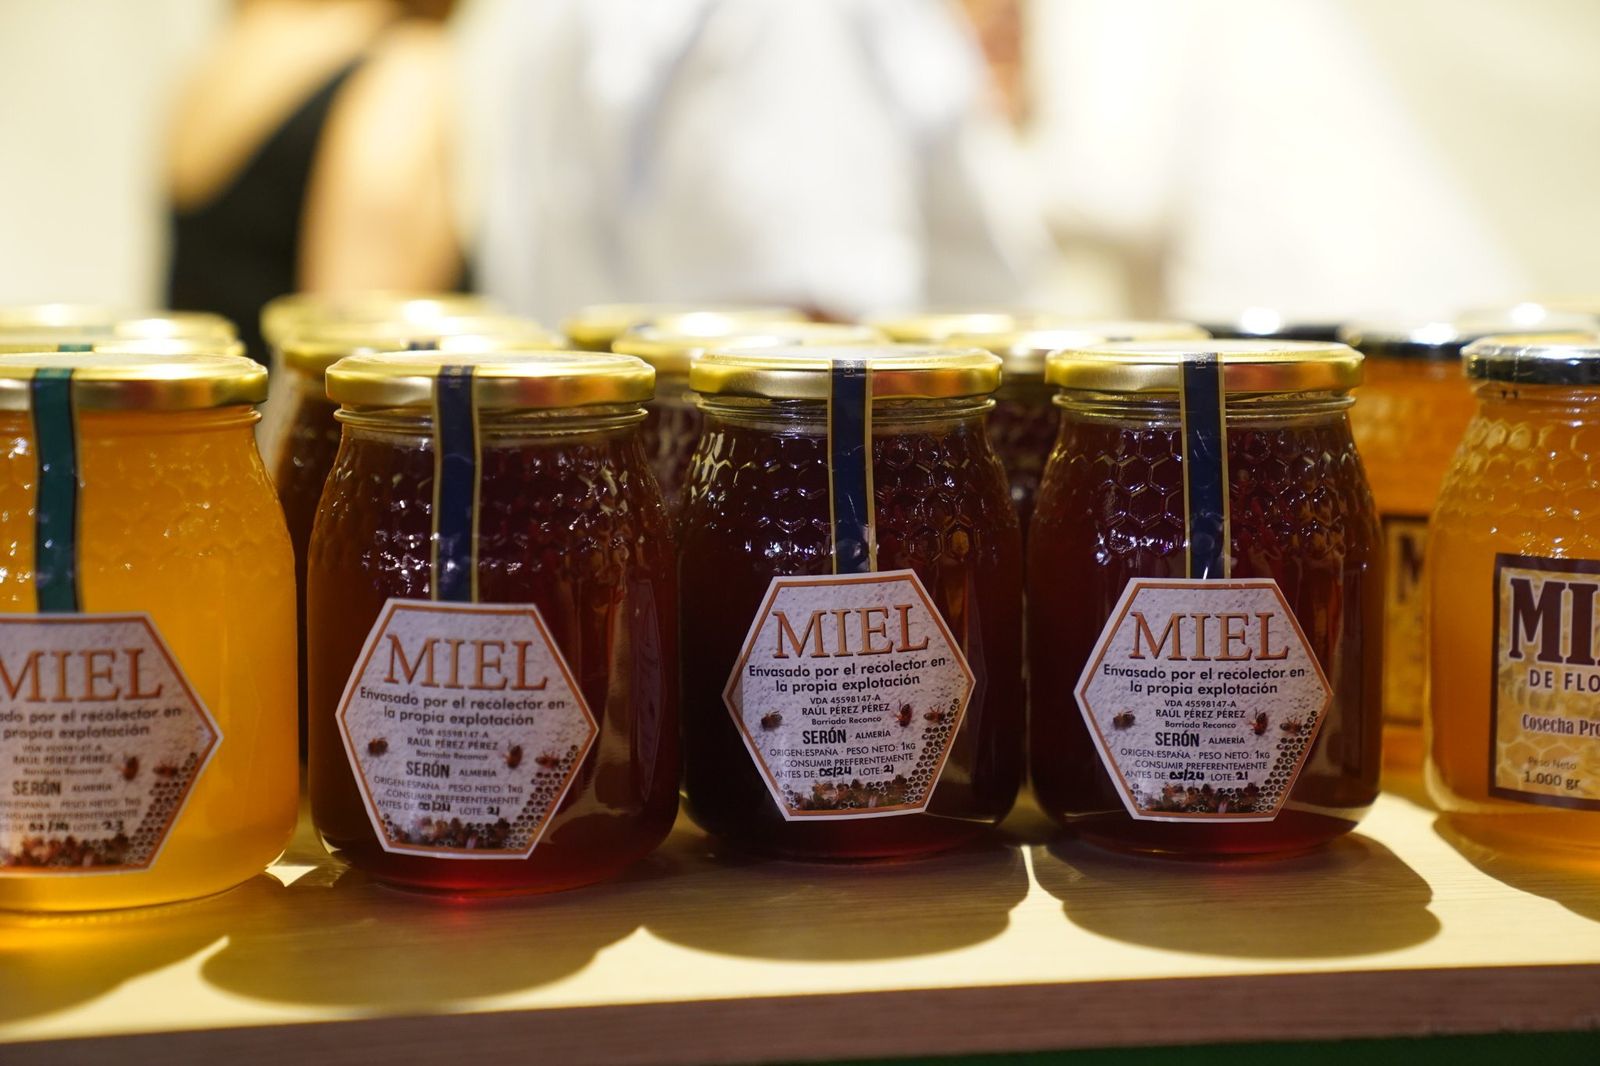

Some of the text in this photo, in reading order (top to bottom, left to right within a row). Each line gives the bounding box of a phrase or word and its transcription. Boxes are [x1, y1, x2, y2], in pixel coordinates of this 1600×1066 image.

[1508, 577, 1600, 666] MI
[771, 603, 931, 659] MIEL
[1128, 611, 1290, 661] MIEL
[383, 633, 549, 692] MIEL
[749, 656, 946, 680] Envasado por el recolector en
[0, 647, 163, 703] MIEL
[1103, 664, 1306, 682] Envasado por el recolector en
[1529, 669, 1553, 689] DE
[775, 673, 920, 695] la propia explotación
[1130, 680, 1279, 698] la propia explotación
[360, 686, 565, 713] Envasado por el recolector en
[810, 694, 881, 705] VDA 45598147-A
[1164, 699, 1237, 708] VDA 45598147-A
[29, 712, 56, 725] por
[61, 708, 76, 722] el
[80, 707, 158, 722] recolector
[163, 705, 182, 719] en
[383, 706, 534, 727] la propia explotación
[802, 702, 890, 716] RAÚL PÉREZ PÉREZ
[1155, 707, 1246, 720] RAÚL PÉREZ PÉREZ
[848, 715, 882, 724] Reconco
[1202, 720, 1237, 729] Reconco
[1522, 713, 1574, 734] Cosecha
[3, 724, 150, 742] propia explotación
[416, 728, 434, 736] VDA
[802, 726, 891, 745] SERÓN ALMERÍA
[1155, 730, 1246, 748] SERÓN ALMERÍA
[407, 736, 499, 751] RAÚL PÉREZ PÉREZ
[846, 746, 869, 756] PESO
[871, 744, 899, 754] NETO:
[785, 752, 914, 768] CONSUMIR PREFERENTEMENTE
[1198, 751, 1222, 760] PESO
[1224, 751, 1253, 760] NETO:
[1528, 756, 1577, 770] Peso Neto
[406, 758, 497, 779] SERÓN ALMERÍA
[775, 770, 801, 779] ANTES
[803, 769, 818, 778] DE:
[1134, 759, 1268, 772] CONSUMIR PREFERENTEMENTE
[1124, 770, 1152, 780] ANTES
[1154, 771, 1169, 780] DE:
[1235, 771, 1249, 780] 21
[1523, 770, 1580, 790] 1.000 gr
[12, 777, 62, 796] SERÓN
[448, 784, 472, 793] PESO
[376, 799, 402, 810] ANTES
[385, 789, 521, 805] CONSUMIR PREFERENTEMENTE
